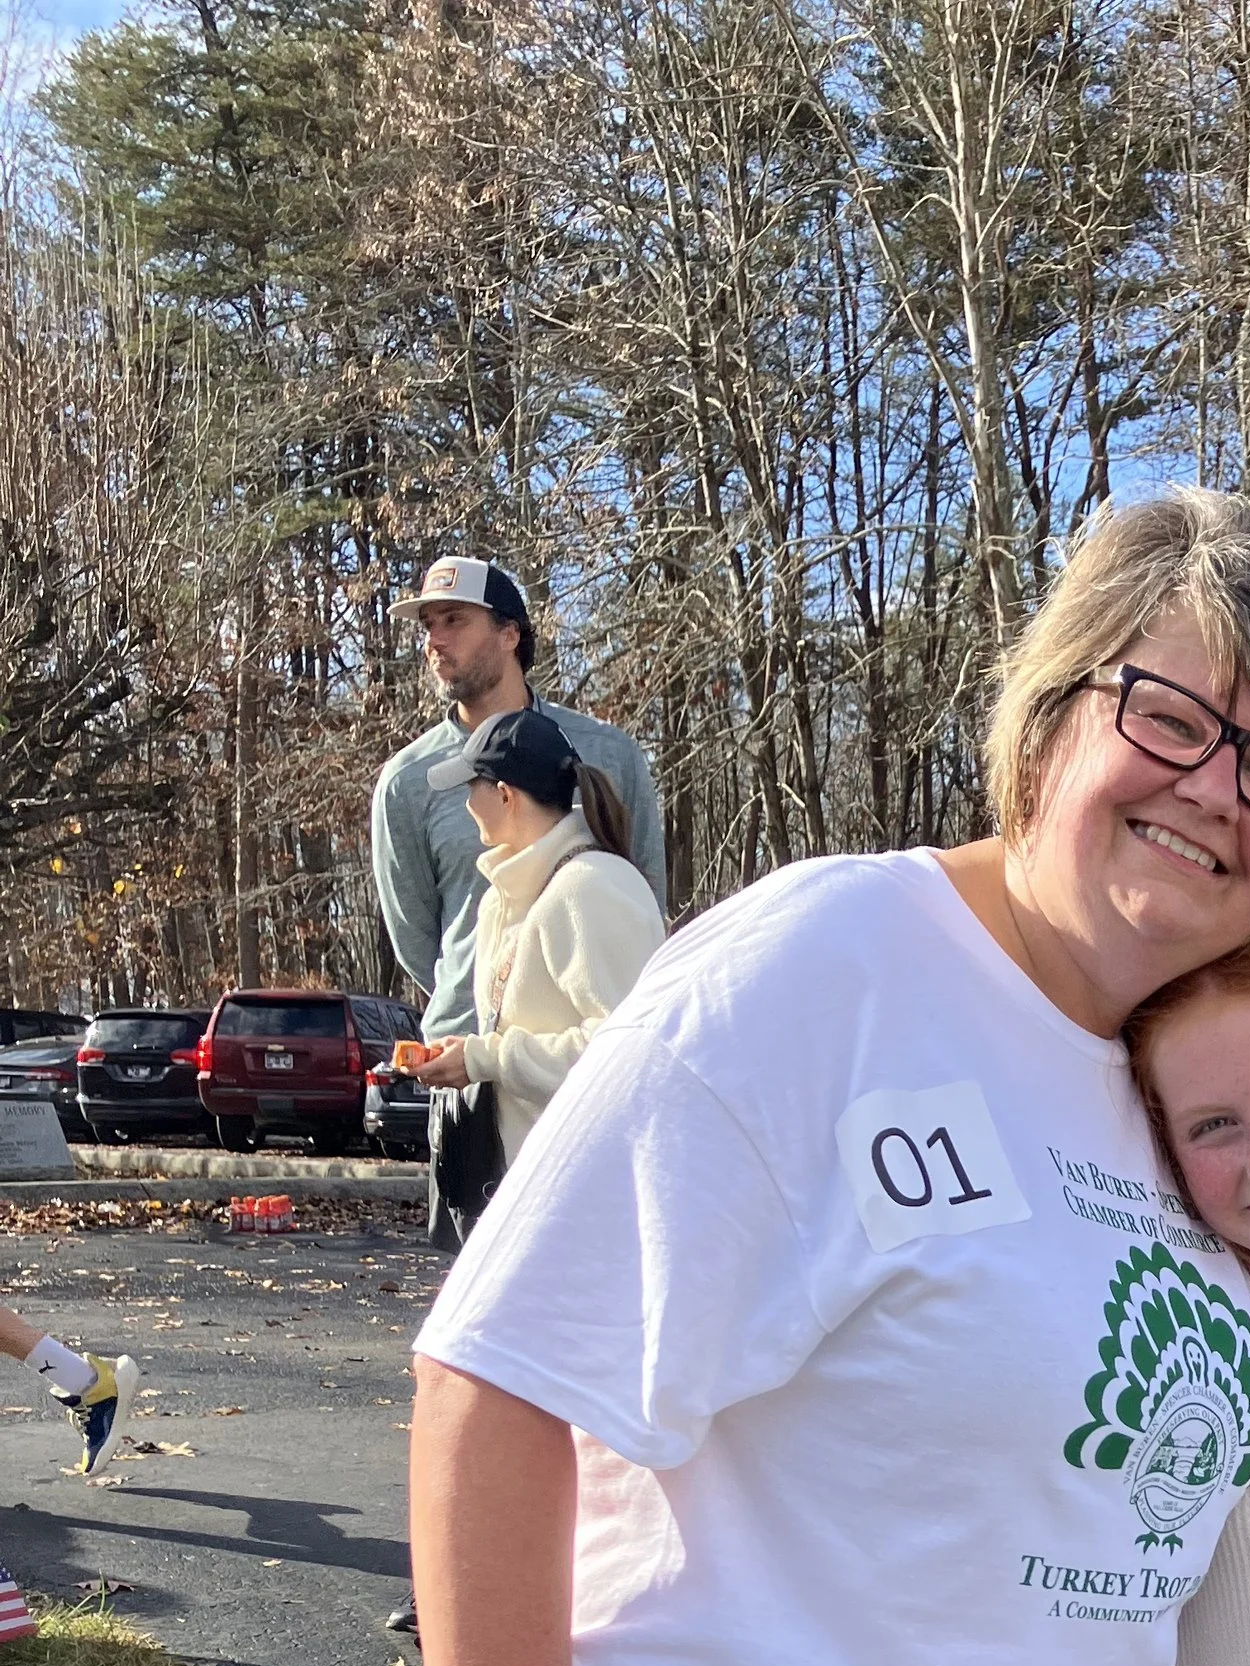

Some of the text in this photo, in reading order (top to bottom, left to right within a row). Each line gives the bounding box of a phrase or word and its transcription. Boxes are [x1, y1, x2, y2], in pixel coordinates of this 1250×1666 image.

[871, 1127, 993, 1207] 01
[1087, 1161, 1149, 1202] BUREN
[1063, 1185, 1141, 1235] CHAMBER
[1140, 1215, 1159, 1240] OF
[1019, 1555, 1135, 1597] TURKEY
[1140, 1568, 1192, 1599] TROT
[1047, 1600, 1060, 1617] A
[1066, 1601, 1153, 1623] COMMUNITY
